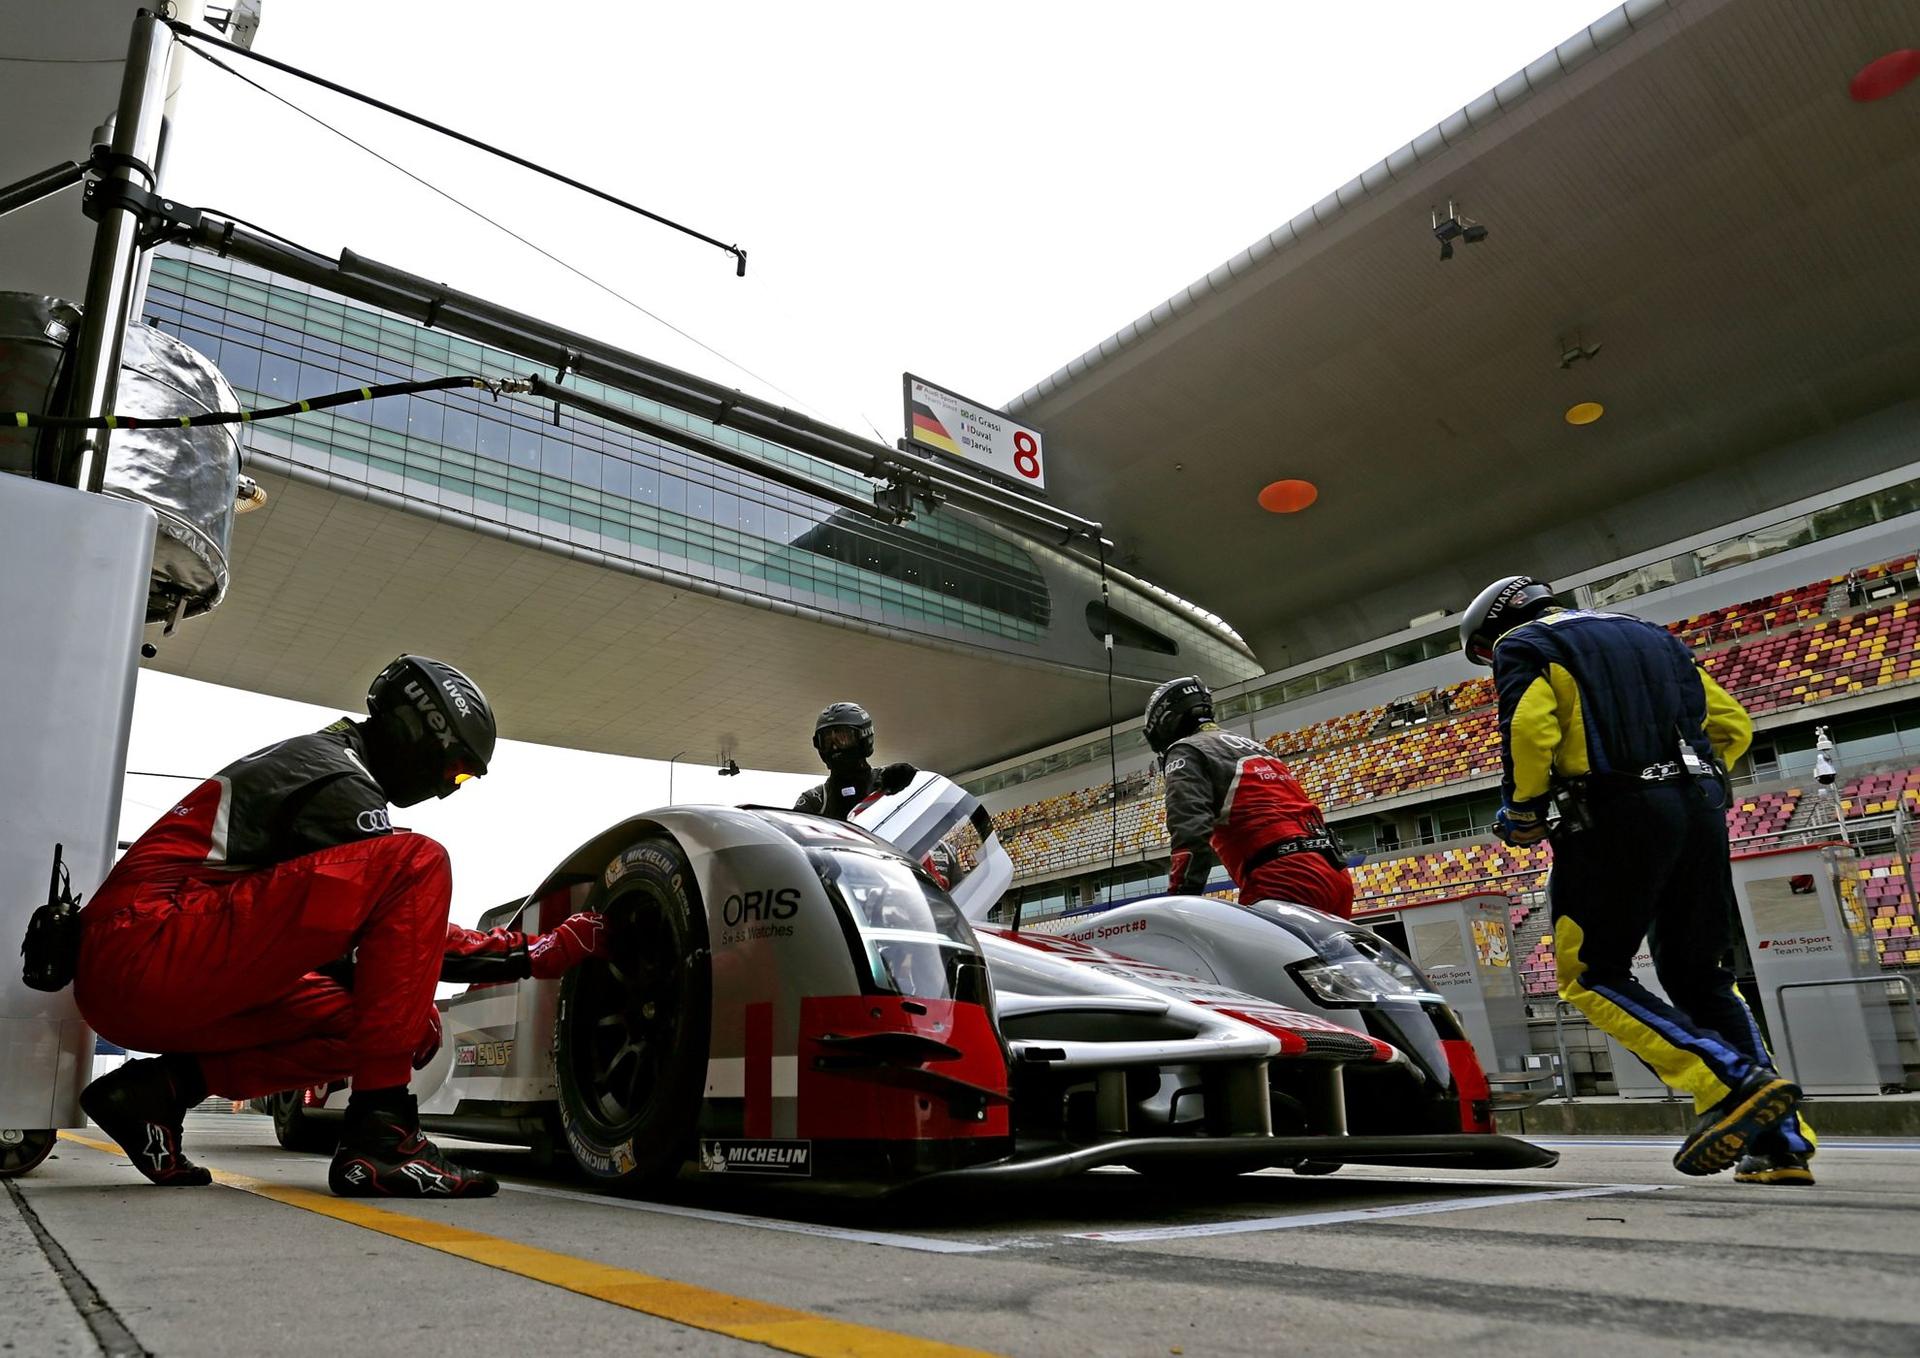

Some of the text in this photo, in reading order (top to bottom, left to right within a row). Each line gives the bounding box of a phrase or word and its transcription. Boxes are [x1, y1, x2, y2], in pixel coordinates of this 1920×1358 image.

[969, 413, 1001, 432] di Grassi
[970, 426, 992, 441] Duval
[971, 439, 992, 454] Jarvis
[1013, 431, 1041, 479] 8
[442, 679, 472, 717] uvex
[403, 680, 459, 749] uvex
[626, 847, 673, 875] MICHELIN
[723, 887, 801, 928] ORIS
[748, 924, 794, 941] Watches
[1070, 930, 1095, 942] Audi
[1772, 935, 1831, 946] Audi Sport
[1774, 944, 1833, 955] Team Joest
[1431, 970, 1471, 980] Audi Sport
[1454, 978, 1473, 986] Joest
[569, 1131, 610, 1170] MICHELIN
[728, 1147, 808, 1164] MICHELIN
